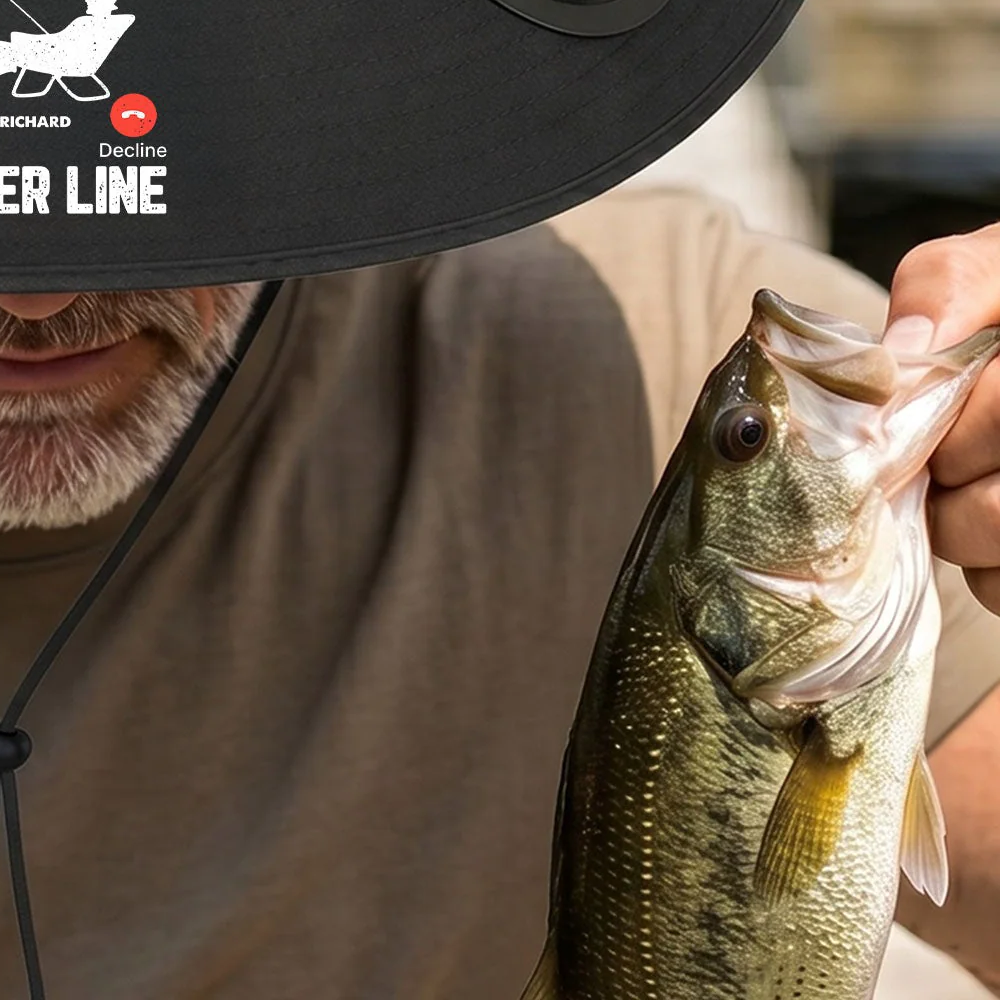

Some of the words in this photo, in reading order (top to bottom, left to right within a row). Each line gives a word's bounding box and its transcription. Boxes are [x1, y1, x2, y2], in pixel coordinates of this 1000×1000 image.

[0, 115, 72, 128] RICHARD
[99, 142, 168, 158] Decline
[66, 165, 168, 215] LINE
